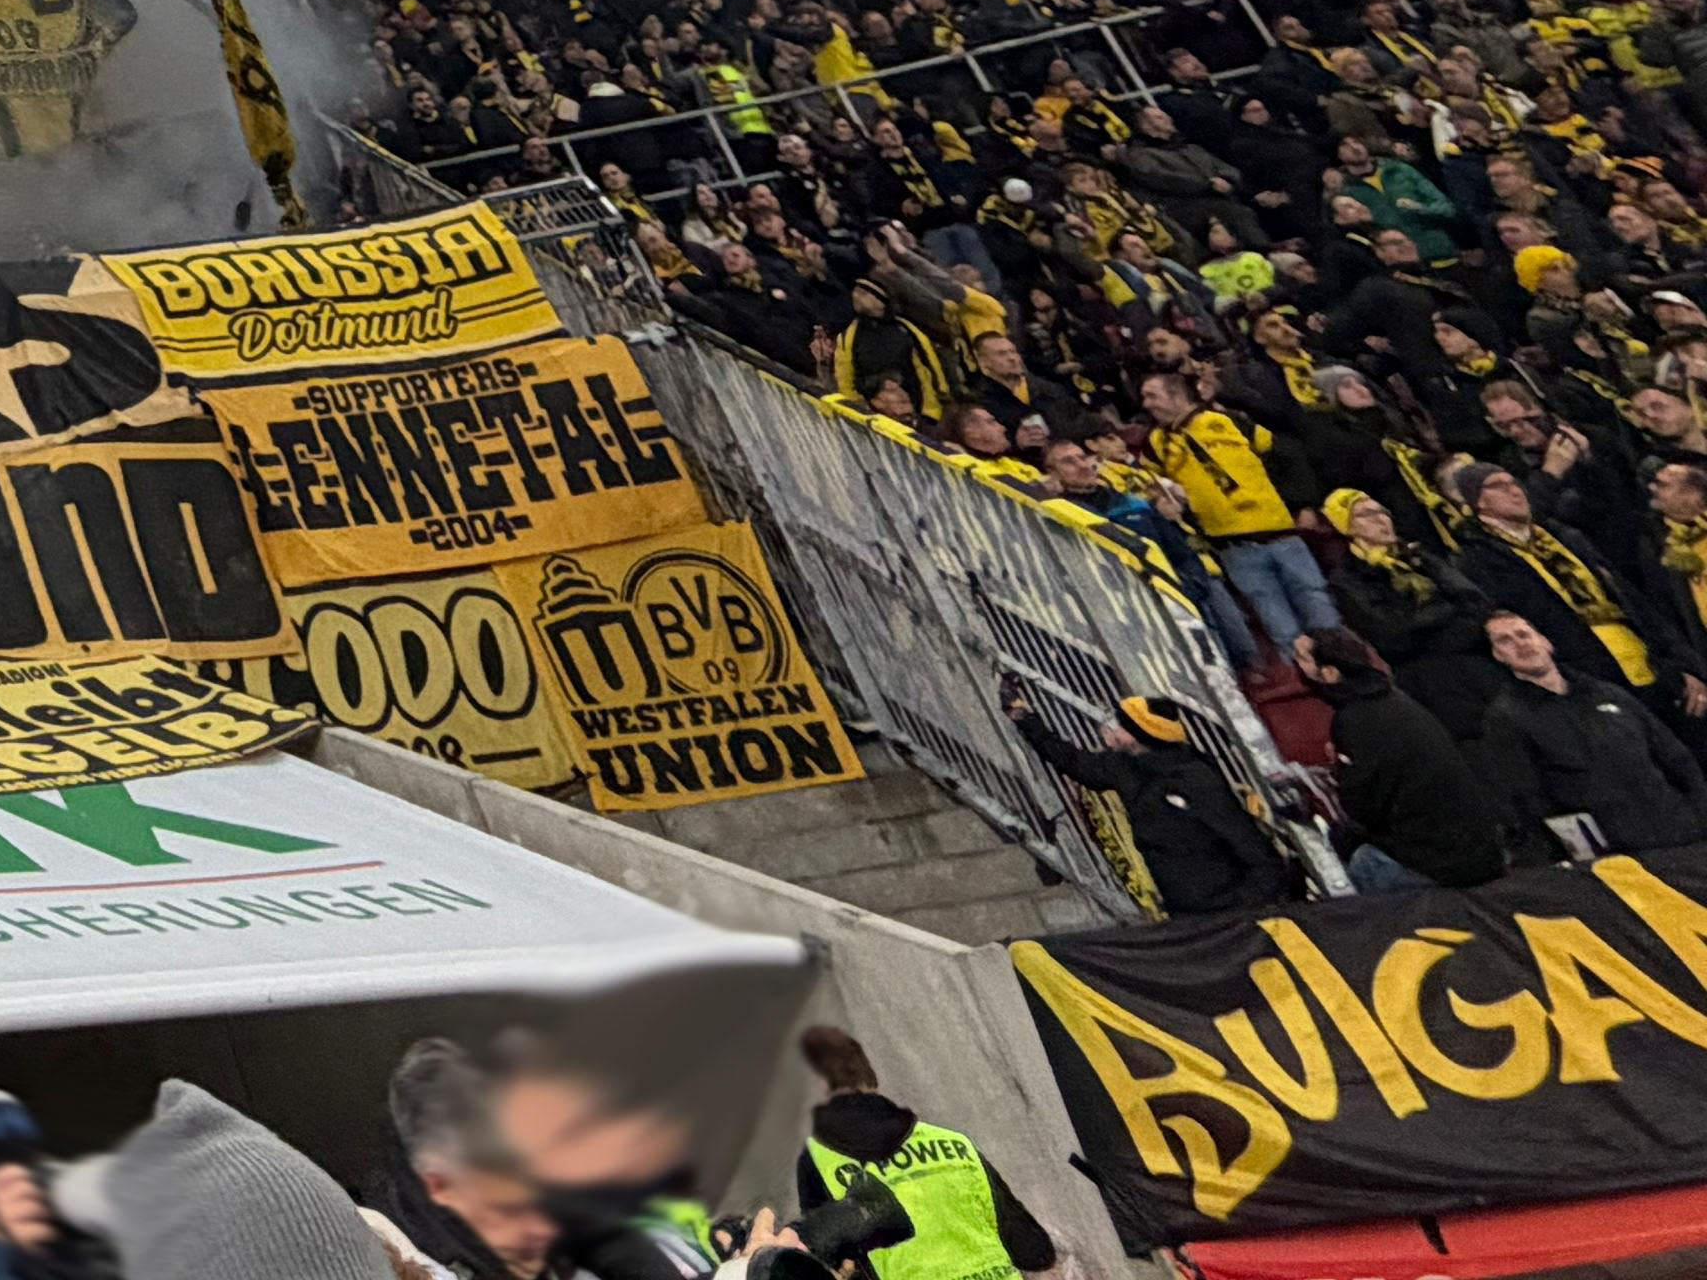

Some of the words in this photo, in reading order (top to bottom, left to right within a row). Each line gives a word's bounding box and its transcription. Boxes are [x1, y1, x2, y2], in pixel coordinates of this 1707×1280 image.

[133, 216, 509, 317] BORUSSIA
[228, 286, 459, 362] Dortmund
[307, 358, 523, 416] SUPPORTERS
[235, 372, 681, 533] LENNETAL
[428, 514, 515, 552] 2004
[645, 573, 766, 660] BVB
[703, 658, 742, 686] 09
[571, 683, 820, 737] WESTFALEN
[591, 722, 843, 797] UNION
